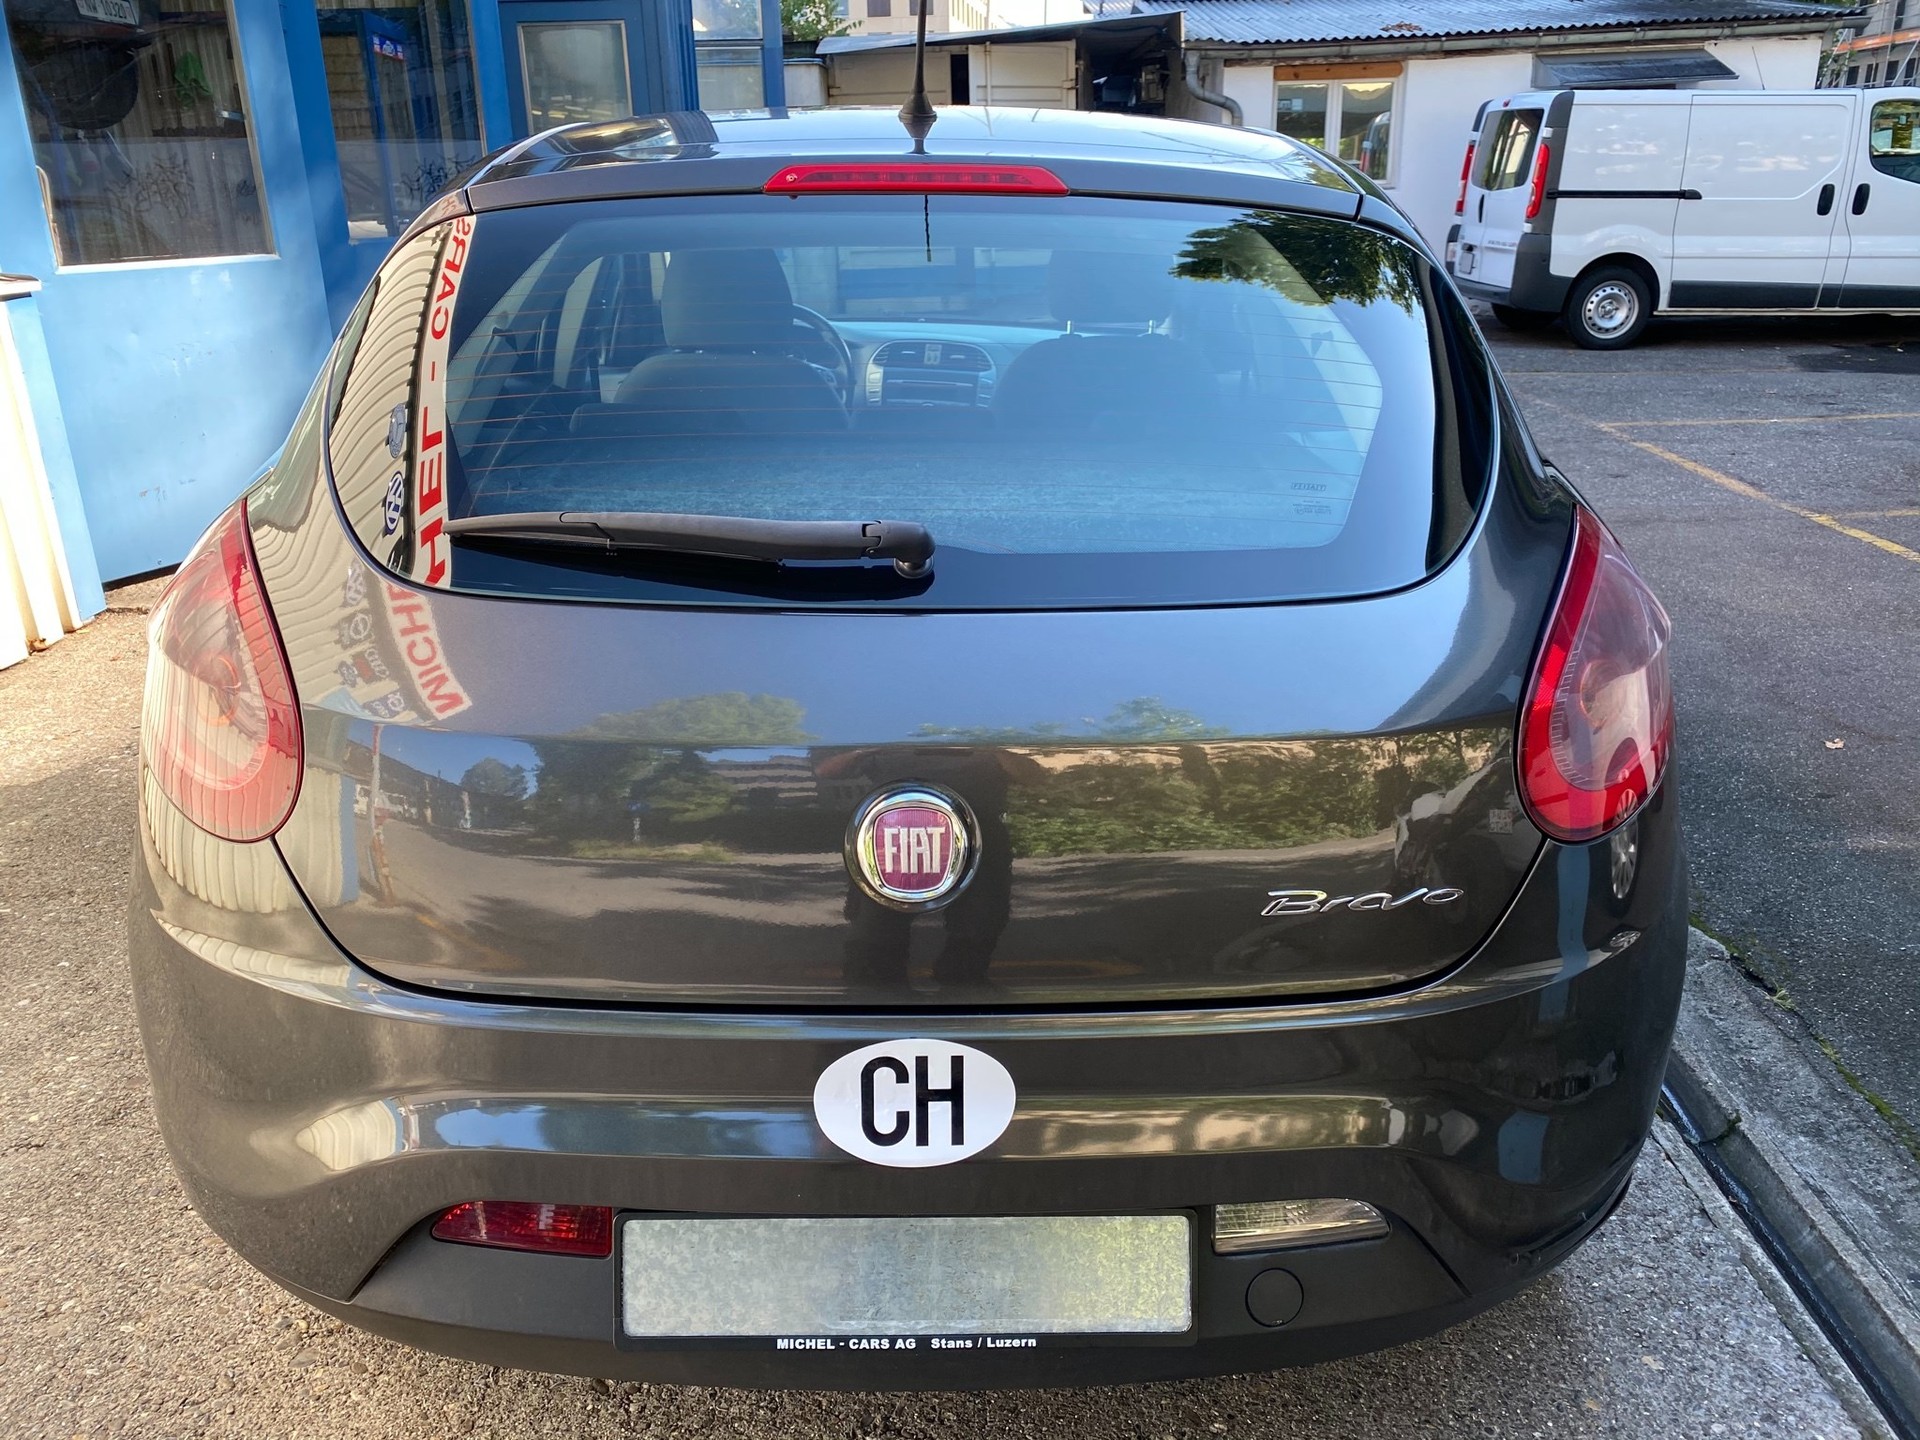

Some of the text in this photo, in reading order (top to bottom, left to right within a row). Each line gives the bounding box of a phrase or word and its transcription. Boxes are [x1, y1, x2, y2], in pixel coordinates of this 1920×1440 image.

[884, 826, 945, 874] FIAT
[1260, 887, 1464, 916] Bravo
[860, 1055, 965, 1147] CH
[777, 1338, 836, 1350] MICHEL
[849, 1338, 890, 1350] CARS
[894, 1338, 916, 1350] AG
[930, 1337, 973, 1349] Stans
[987, 1336, 1037, 1348] Luzern
